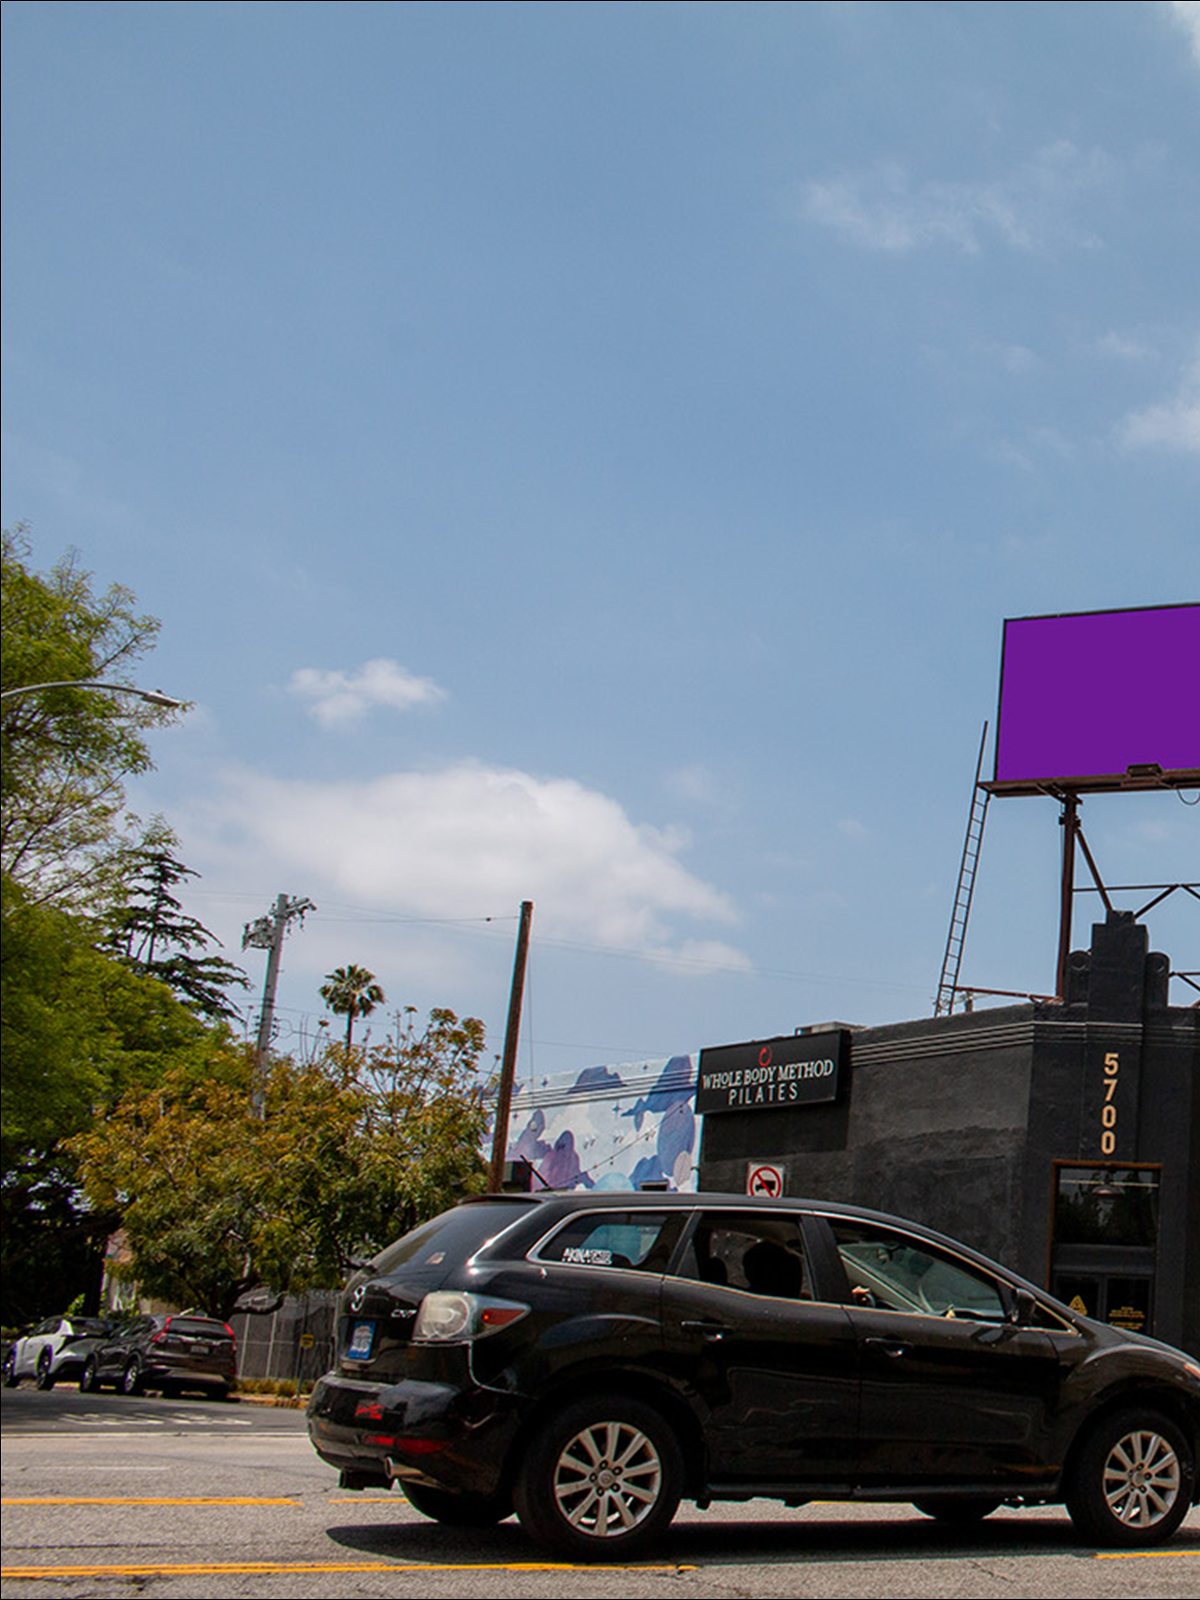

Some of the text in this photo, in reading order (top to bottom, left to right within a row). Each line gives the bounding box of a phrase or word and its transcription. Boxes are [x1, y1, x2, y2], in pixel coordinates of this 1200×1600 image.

[702, 1058, 834, 1090] WHOLE BODY METHOD
[728, 1081, 798, 1106] PILATES
[1101, 1052, 1119, 1155] 5700
